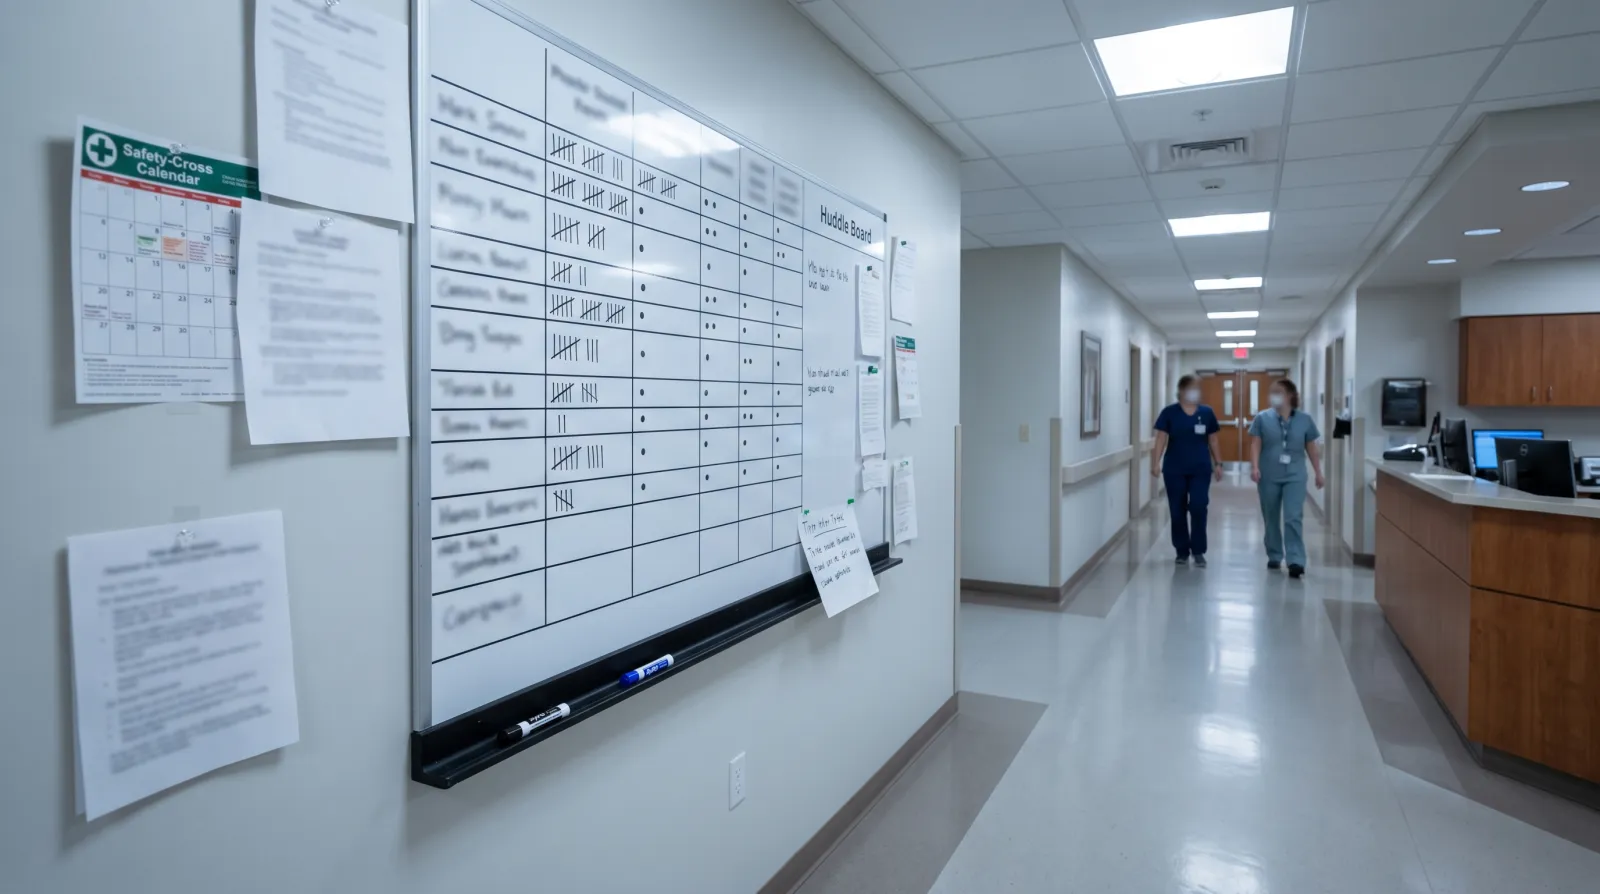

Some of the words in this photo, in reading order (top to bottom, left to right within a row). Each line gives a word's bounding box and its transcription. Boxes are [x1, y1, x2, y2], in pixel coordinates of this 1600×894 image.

[123, 143, 213, 175] Safety-Cross
[136, 162, 200, 186] Calendar
[820, 204, 849, 234] Huddle
[850, 219, 871, 244] Board
